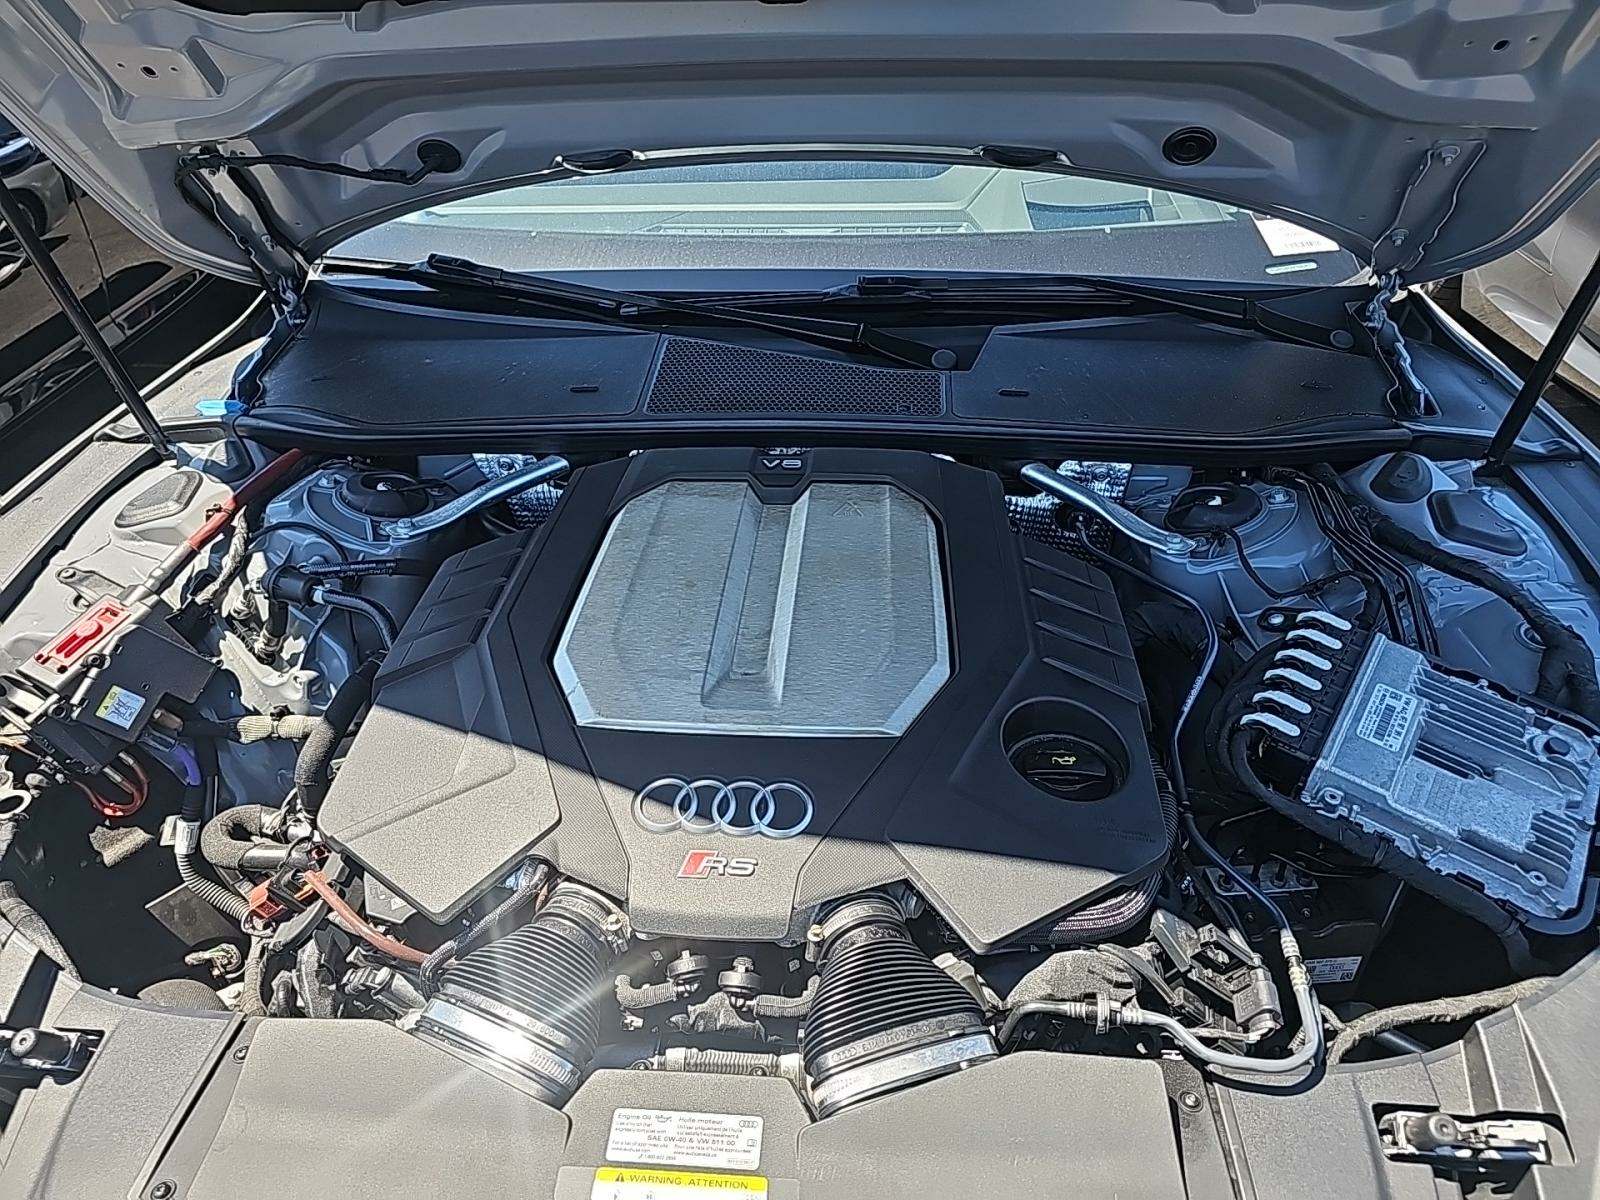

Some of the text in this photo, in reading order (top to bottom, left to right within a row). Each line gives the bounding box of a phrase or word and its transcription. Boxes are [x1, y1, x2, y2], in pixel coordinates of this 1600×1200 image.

[692, 855, 758, 877] RS
[629, 1174, 749, 1189] WARNING ATTENTION
